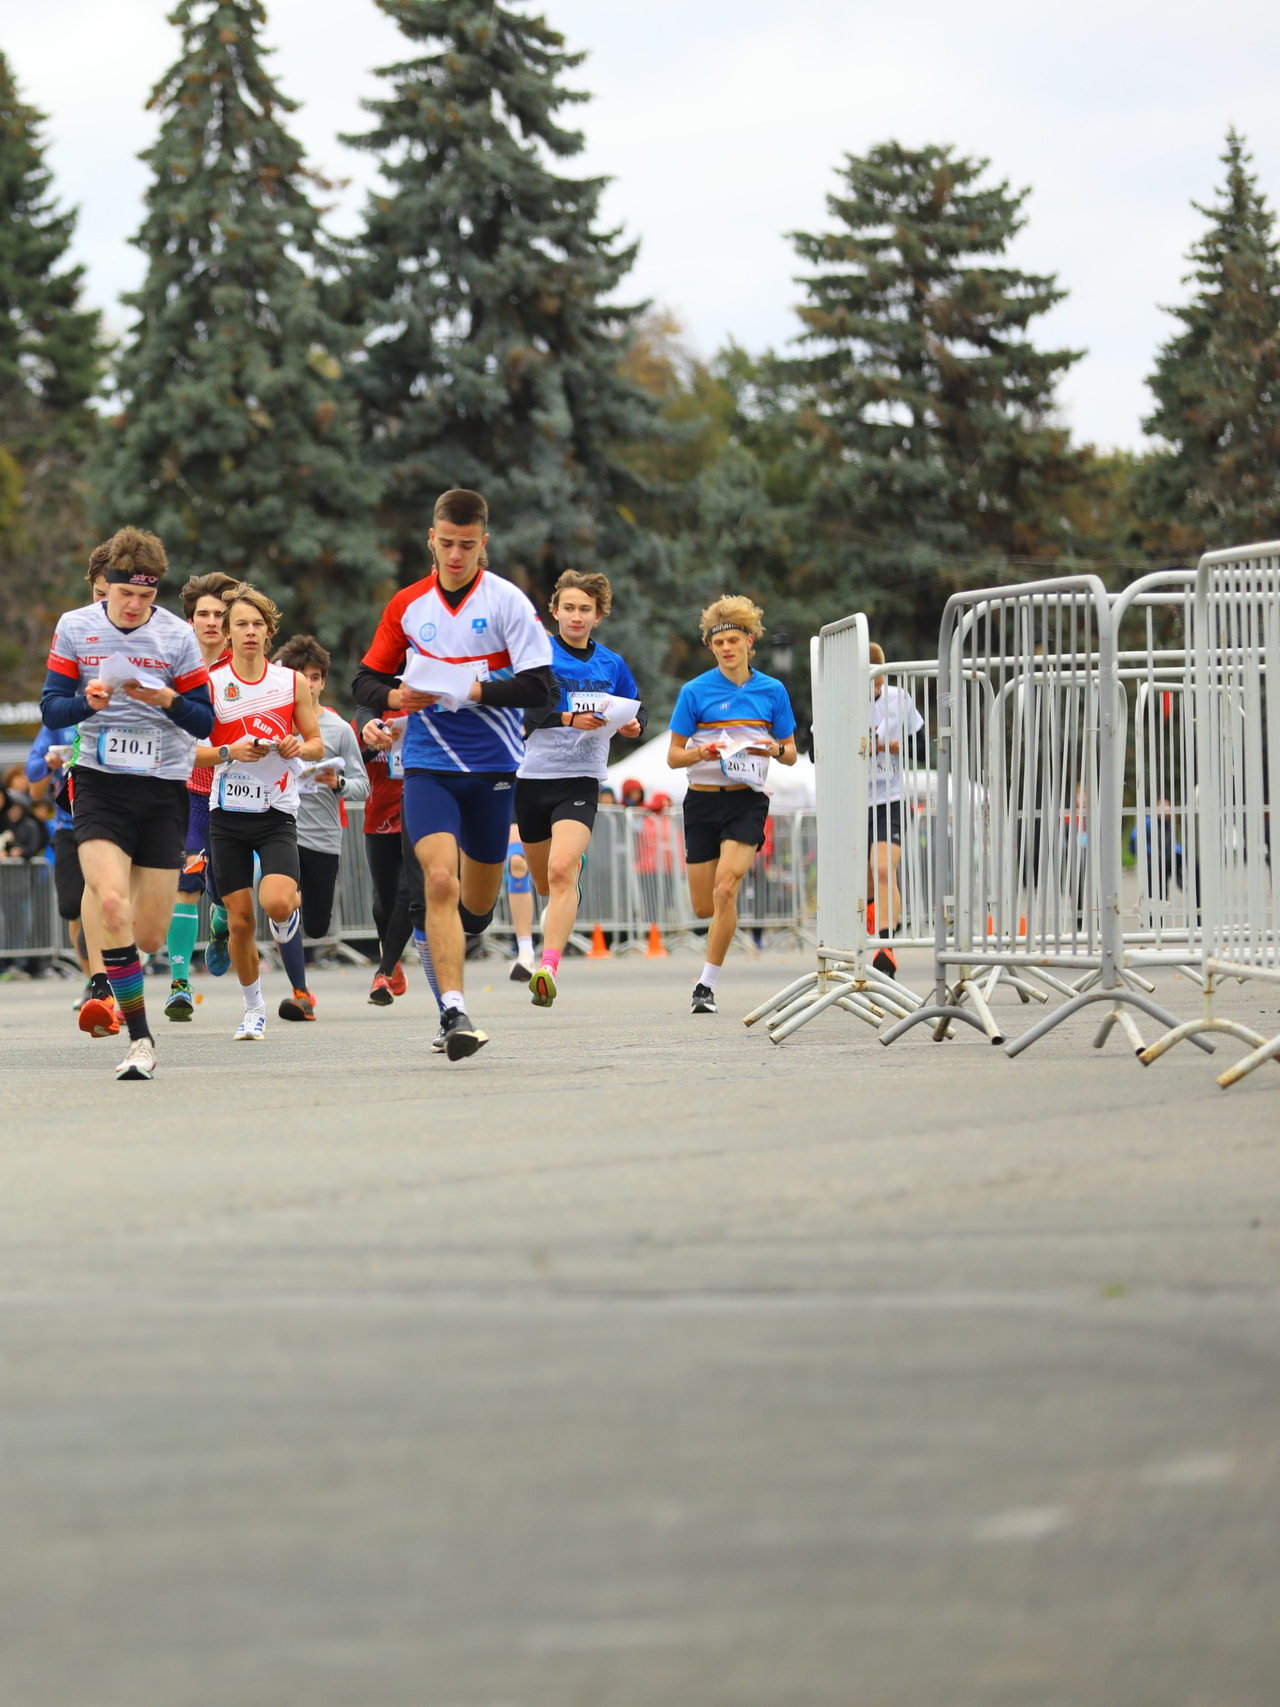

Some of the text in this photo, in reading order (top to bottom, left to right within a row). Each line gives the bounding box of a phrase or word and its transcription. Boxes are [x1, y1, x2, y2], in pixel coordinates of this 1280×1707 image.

[252, 717, 273, 736] Run
[109, 738, 152, 755] 210.1
[727, 761, 756, 772] 202.1
[226, 784, 261, 798] 209.1
